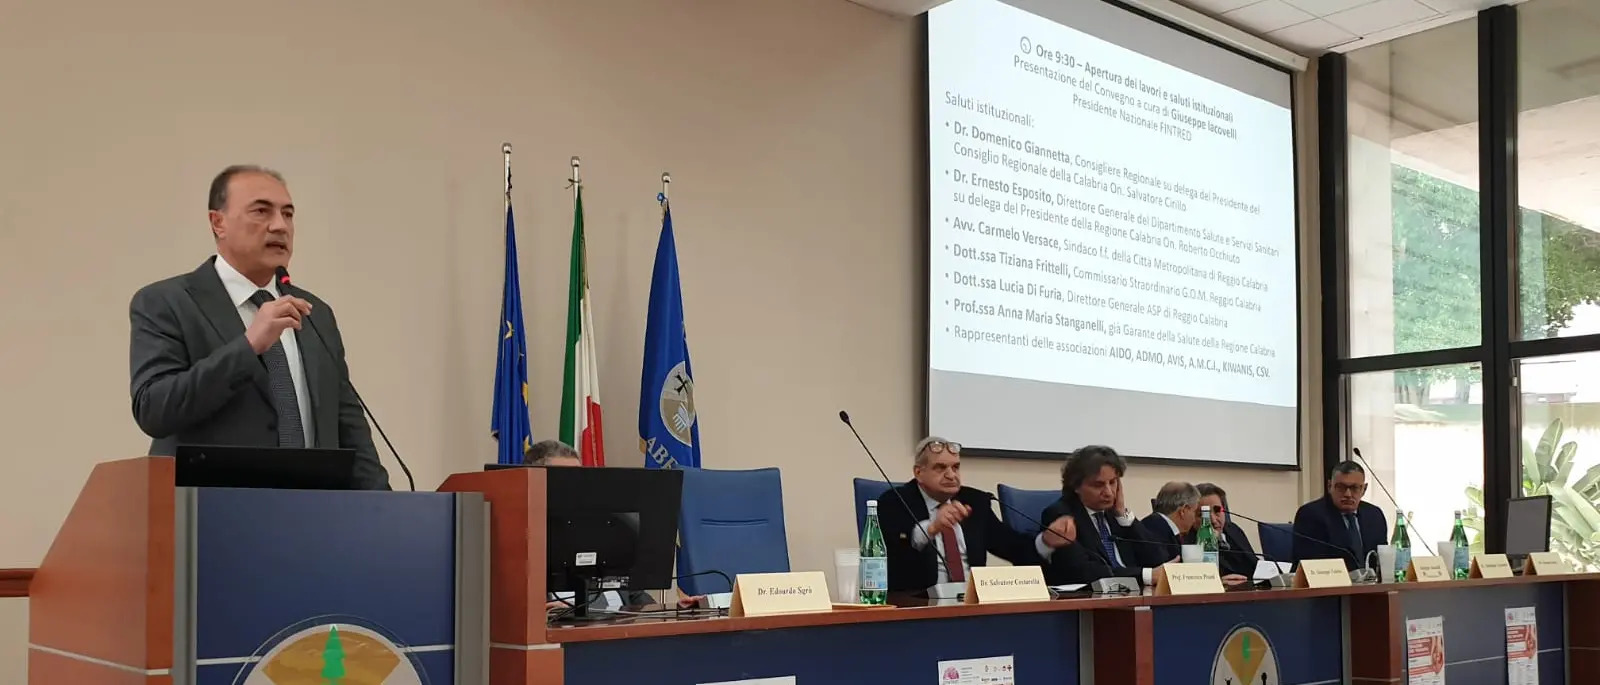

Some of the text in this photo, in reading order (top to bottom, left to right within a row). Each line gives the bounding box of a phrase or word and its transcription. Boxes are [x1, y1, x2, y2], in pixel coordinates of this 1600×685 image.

[945, 91, 1035, 128] Saluti istituzionali:
[1014, 55, 1077, 87] Presentazione
[1079, 77, 1092, 92] del
[1094, 82, 1135, 105] Convegno
[1143, 101, 1160, 114] cura
[1162, 105, 1169, 117] di
[1171, 108, 1206, 129] Giuseppe
[1036, 44, 1053, 61] Ore
[1055, 51, 1075, 68] 9:30
[1084, 62, 1122, 85] Apertura
[1125, 76, 1138, 90] dei
[1139, 80, 1161, 96] lavori
[1163, 91, 1168, 100] e
[1170, 93, 1190, 108] saluti
[1192, 98, 1234, 123] istituzionali
[1073, 93, 1192, 141] Presidente Nazionale FINTRED
[954, 120, 968, 137] Dr.
[972, 125, 1022, 151] Domenico
[1024, 140, 1073, 166] Giannetta,
[1075, 154, 1121, 178] Consigliere
[1123, 167, 1161, 188] Regionale
[954, 141, 999, 165] Consiglio
[1002, 153, 1048, 177] Regionale
[1050, 165, 1071, 183] della
[1073, 172, 1108, 192] Calabria
[1126, 186, 1162, 206] Salvatore
[953, 168, 968, 184] Dr.
[971, 172, 1009, 193] Ernesto
[1012, 181, 1054, 206] Esposito,
[1056, 193, 1095, 214] Direttore
[1098, 203, 1135, 223] Generale
[1137, 213, 1149, 226] del
[1151, 216, 1201, 238] Dipartimento
[953, 192, 965, 203] su
[968, 192, 1000, 213] delega
[1003, 200, 1018, 215] del
[1020, 203, 1069, 226] Presidente
[1071, 216, 1092, 231] della
[1094, 220, 1128, 238] Regione
[1129, 228, 1161, 247] Calabria
[1179, 239, 1208, 257] Roberto
[953, 216, 975, 233] Avv.
[978, 221, 1020, 241] Carmelo
[1022, 230, 1061, 252] Versace,
[1063, 239, 1098, 257] Sindaco
[1112, 249, 1131, 264] della
[1153, 258, 1207, 280] Metropolitana
[953, 243, 997, 263] Dott.ssa
[999, 251, 1033, 270] Tiziana
[1036, 258, 1071, 279] Frittelli,
[1073, 265, 1127, 287] Commissario
[1129, 276, 1181, 296] Straordinario
[953, 271, 997, 290] Dott.ssa
[999, 279, 1024, 294] Lucia
[1027, 283, 1037, 296] Di
[1039, 285, 1064, 303] Furia,
[1067, 290, 1106, 308] Direttore
[1108, 297, 1145, 314] Generale
[1146, 304, 1162, 316] ASP
[1163, 306, 1171, 318] di
[954, 297, 995, 316] Prof.ssa
[997, 304, 1023, 320] Anna
[1025, 308, 1053, 325] Maria
[1055, 313, 1107, 335] Stanganelli,
[1123, 323, 1155, 340] Garante
[1157, 329, 1176, 342] della
[954, 325, 1029, 346] Rappresentanti
[1031, 335, 1054, 350] delle
[1056, 339, 1107, 357] associazioni
[1109, 346, 1134, 362] AIDO,
[1135, 349, 1165, 367] ADMO,
[1167, 354, 1187, 369] AVIS,
